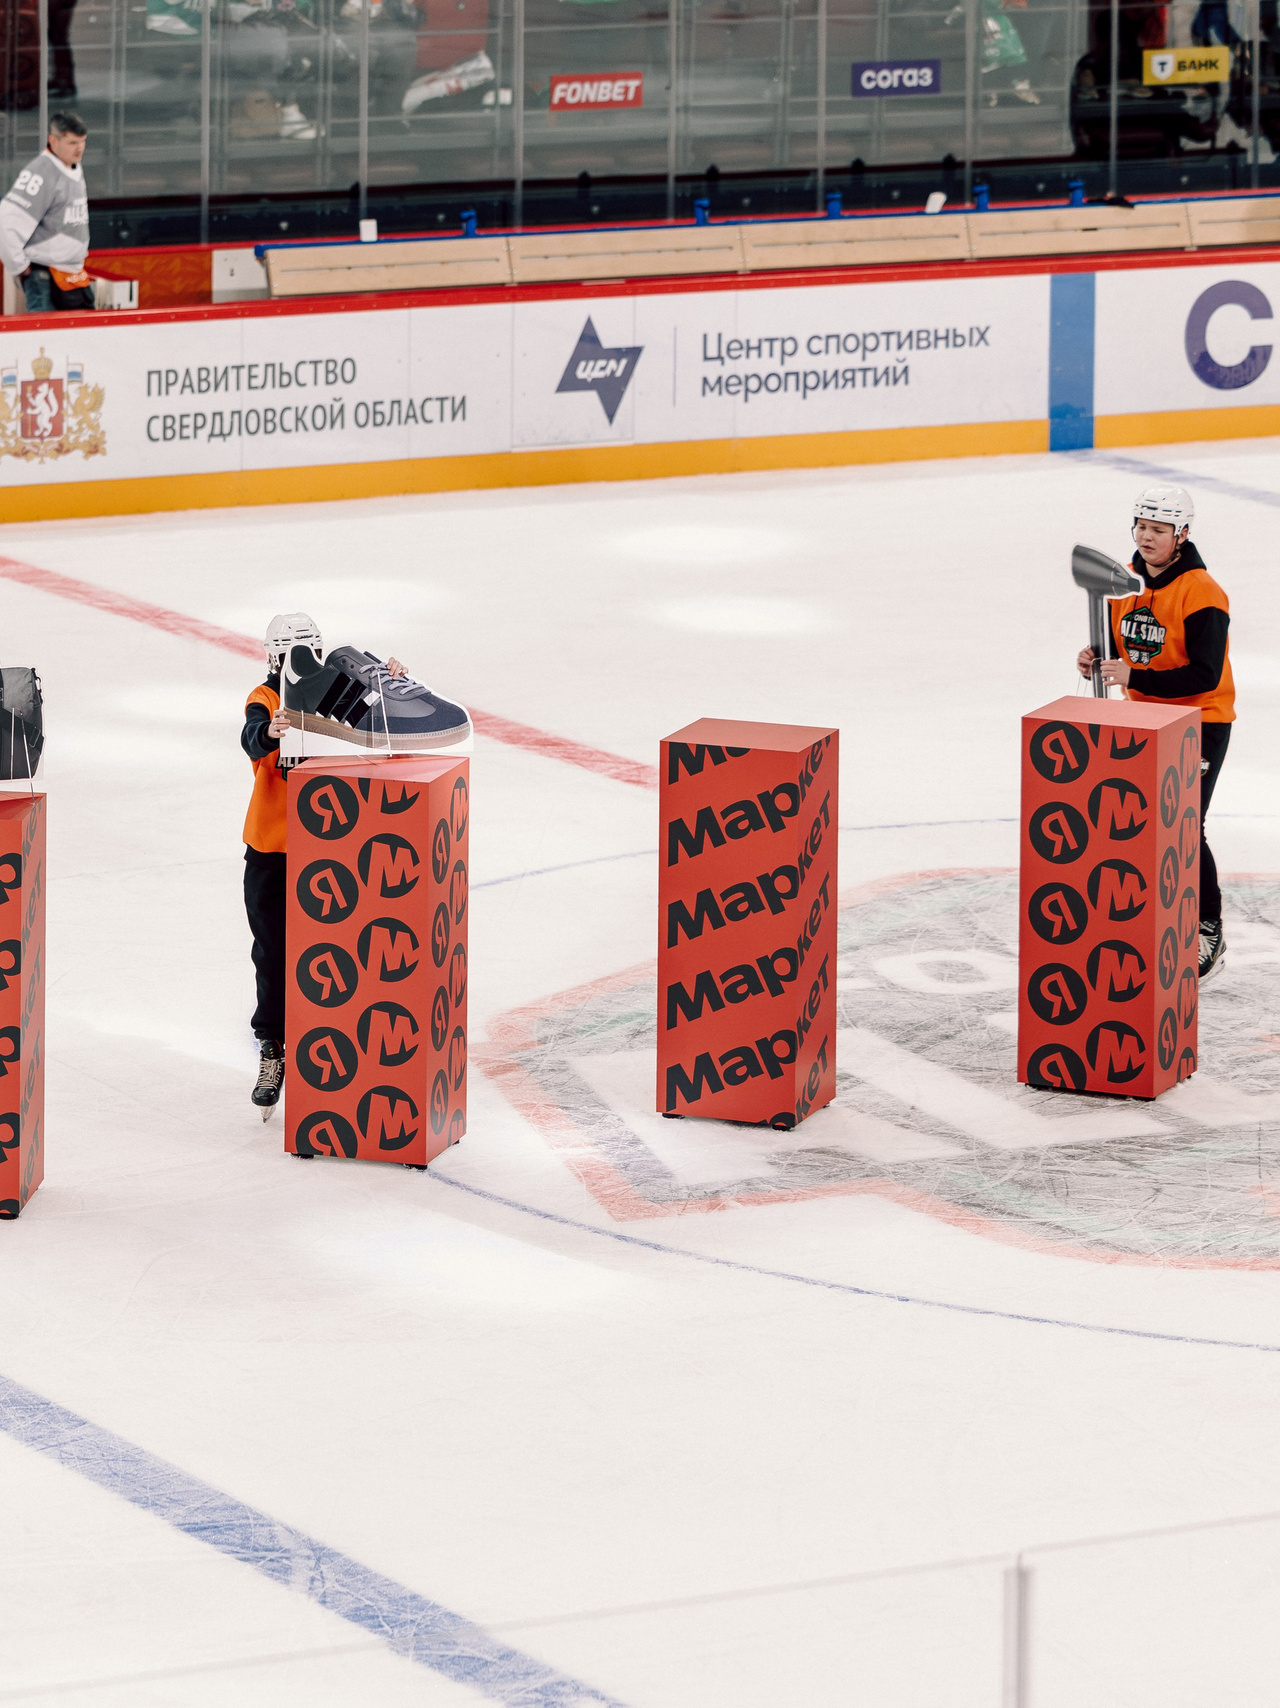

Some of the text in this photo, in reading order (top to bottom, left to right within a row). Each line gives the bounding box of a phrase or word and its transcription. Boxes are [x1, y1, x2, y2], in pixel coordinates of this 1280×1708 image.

[861, 67, 934, 91] согаз
[1177, 60, 1219, 72] БАНК
[552, 79, 642, 104] FONBET
[13, 169, 44, 196] 26
[702, 325, 991, 366] Центр спортивных
[147, 358, 357, 397] ПРАВИТЕЛЬСТВО
[701, 358, 910, 403] мероприятий
[147, 395, 467, 443] СВЕРДЛОВСКОЙ ОБЛАСТИ
[1121, 620, 1165, 643] ALL STAR
